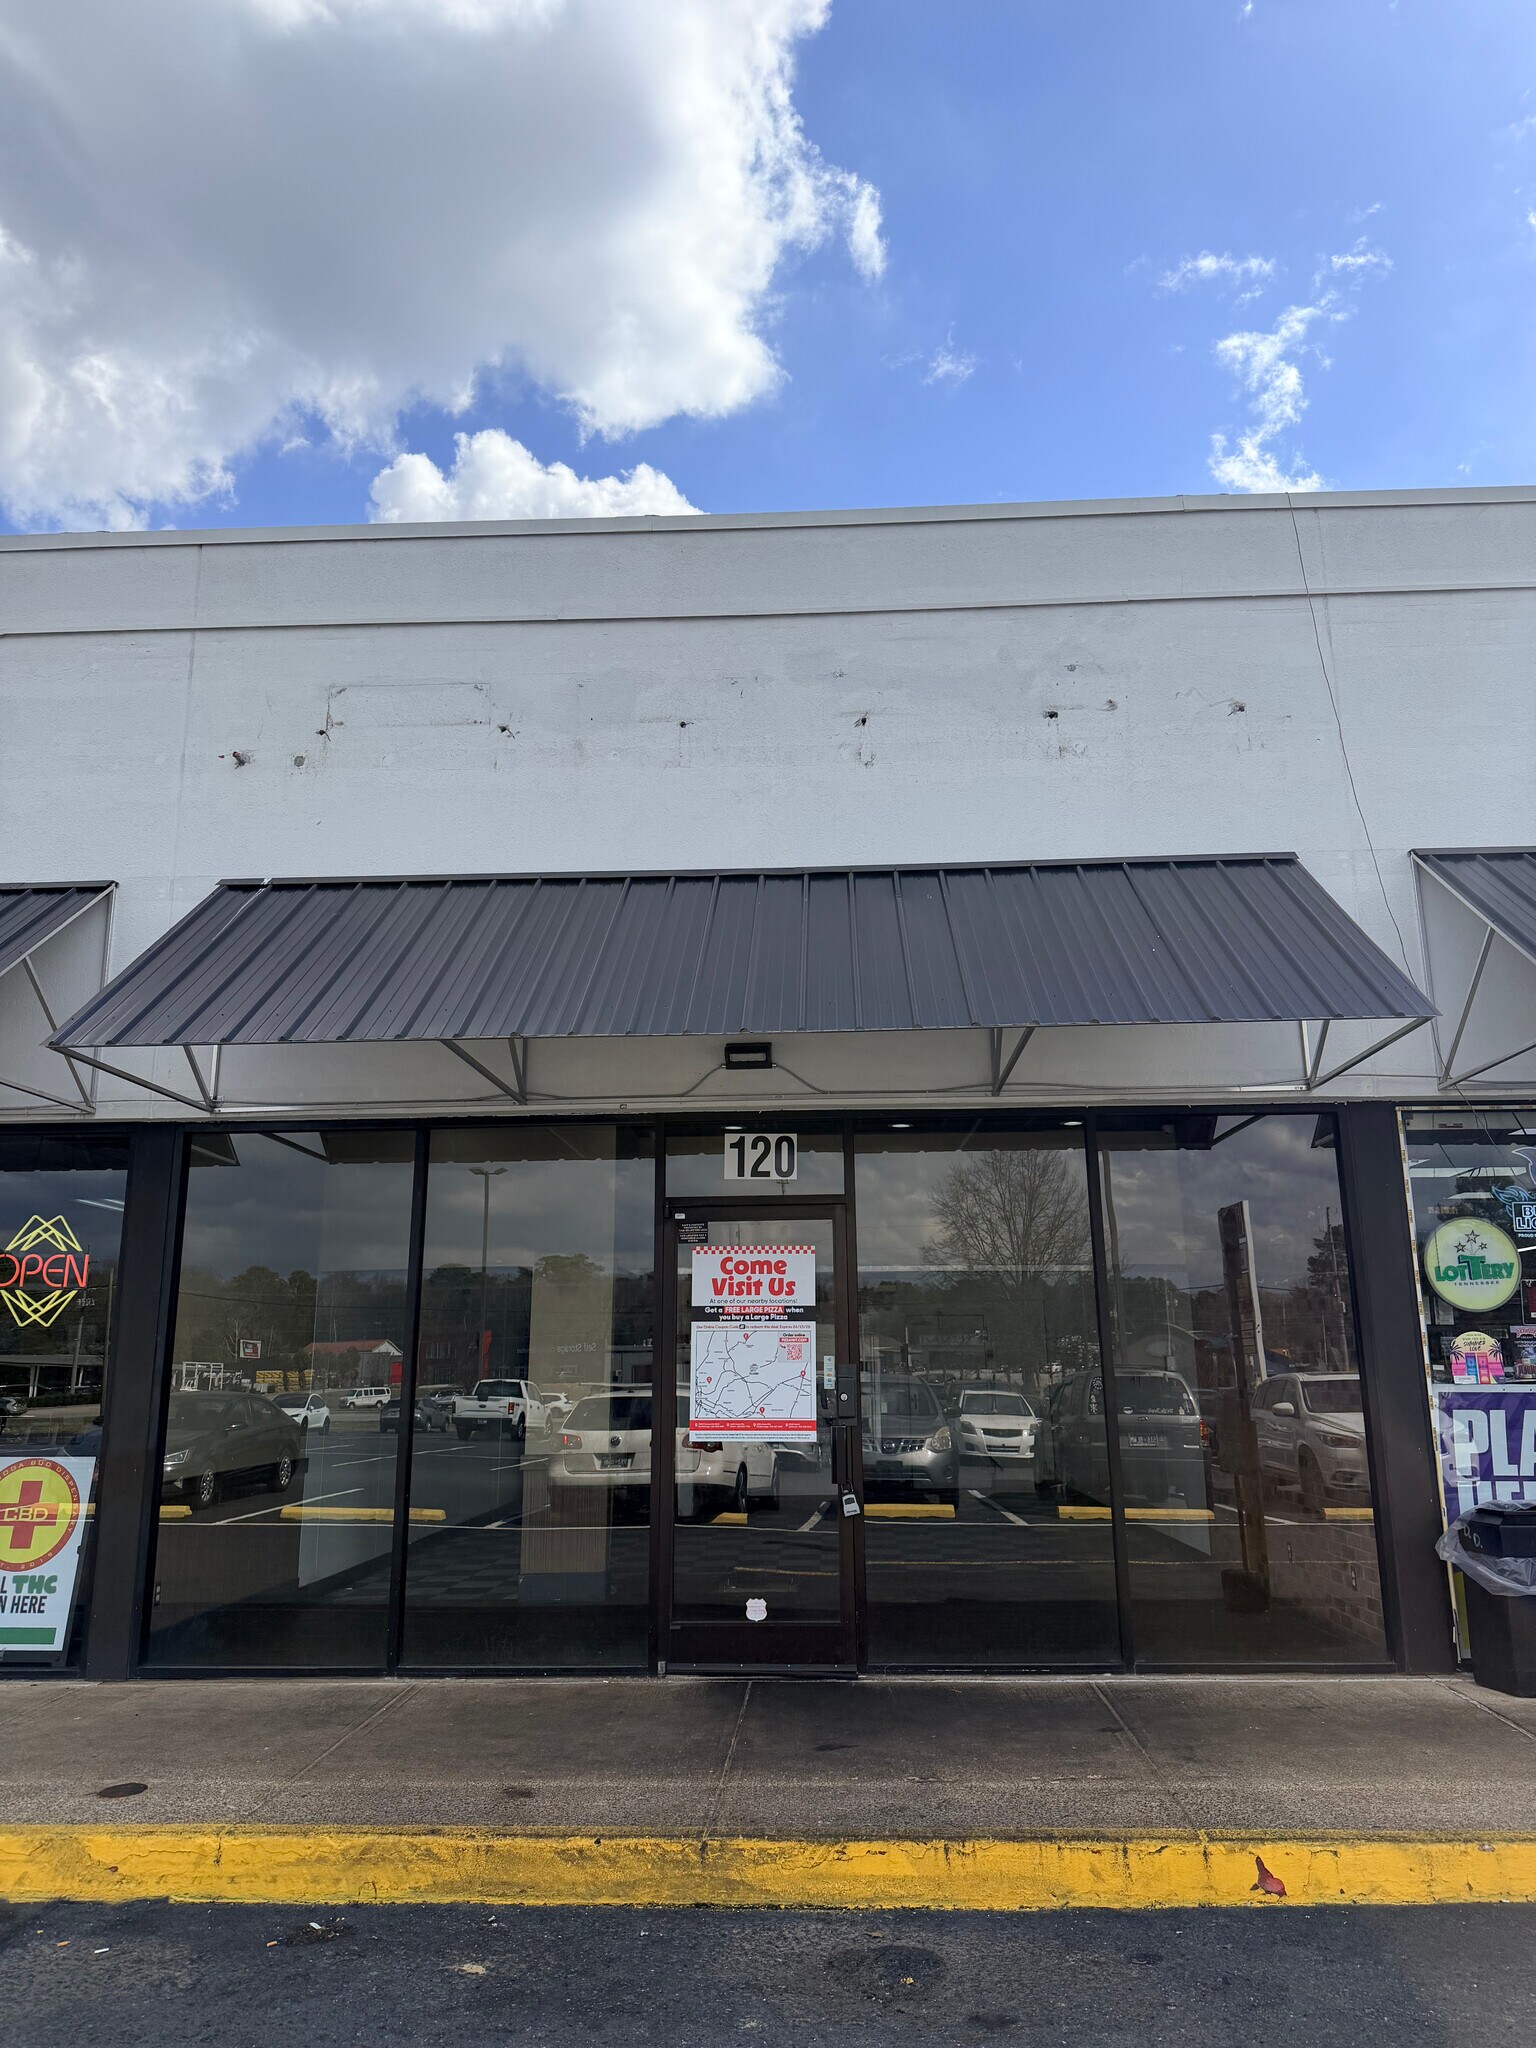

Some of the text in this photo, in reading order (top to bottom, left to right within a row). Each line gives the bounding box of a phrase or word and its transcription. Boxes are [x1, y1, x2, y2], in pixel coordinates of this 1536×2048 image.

[730, 1136, 795, 1177] 120
[1522, 1205, 1536, 1217] B
[0, 1253, 90, 1288] OPEN
[720, 1256, 787, 1275] Come
[1434, 1254, 1514, 1282] LOTTERY
[711, 1275, 796, 1296] Visit Us
[731, 1313, 744, 1321] buy
[750, 1313, 769, 1321] Large
[0, 1463, 24, 1480] OGA
[30, 1460, 52, 1468] BUD
[4, 1507, 48, 1521] CBD
[20, 1552, 53, 1569] 2019
[12, 1574, 58, 1594] THC
[10, 1595, 47, 1613] HERE
